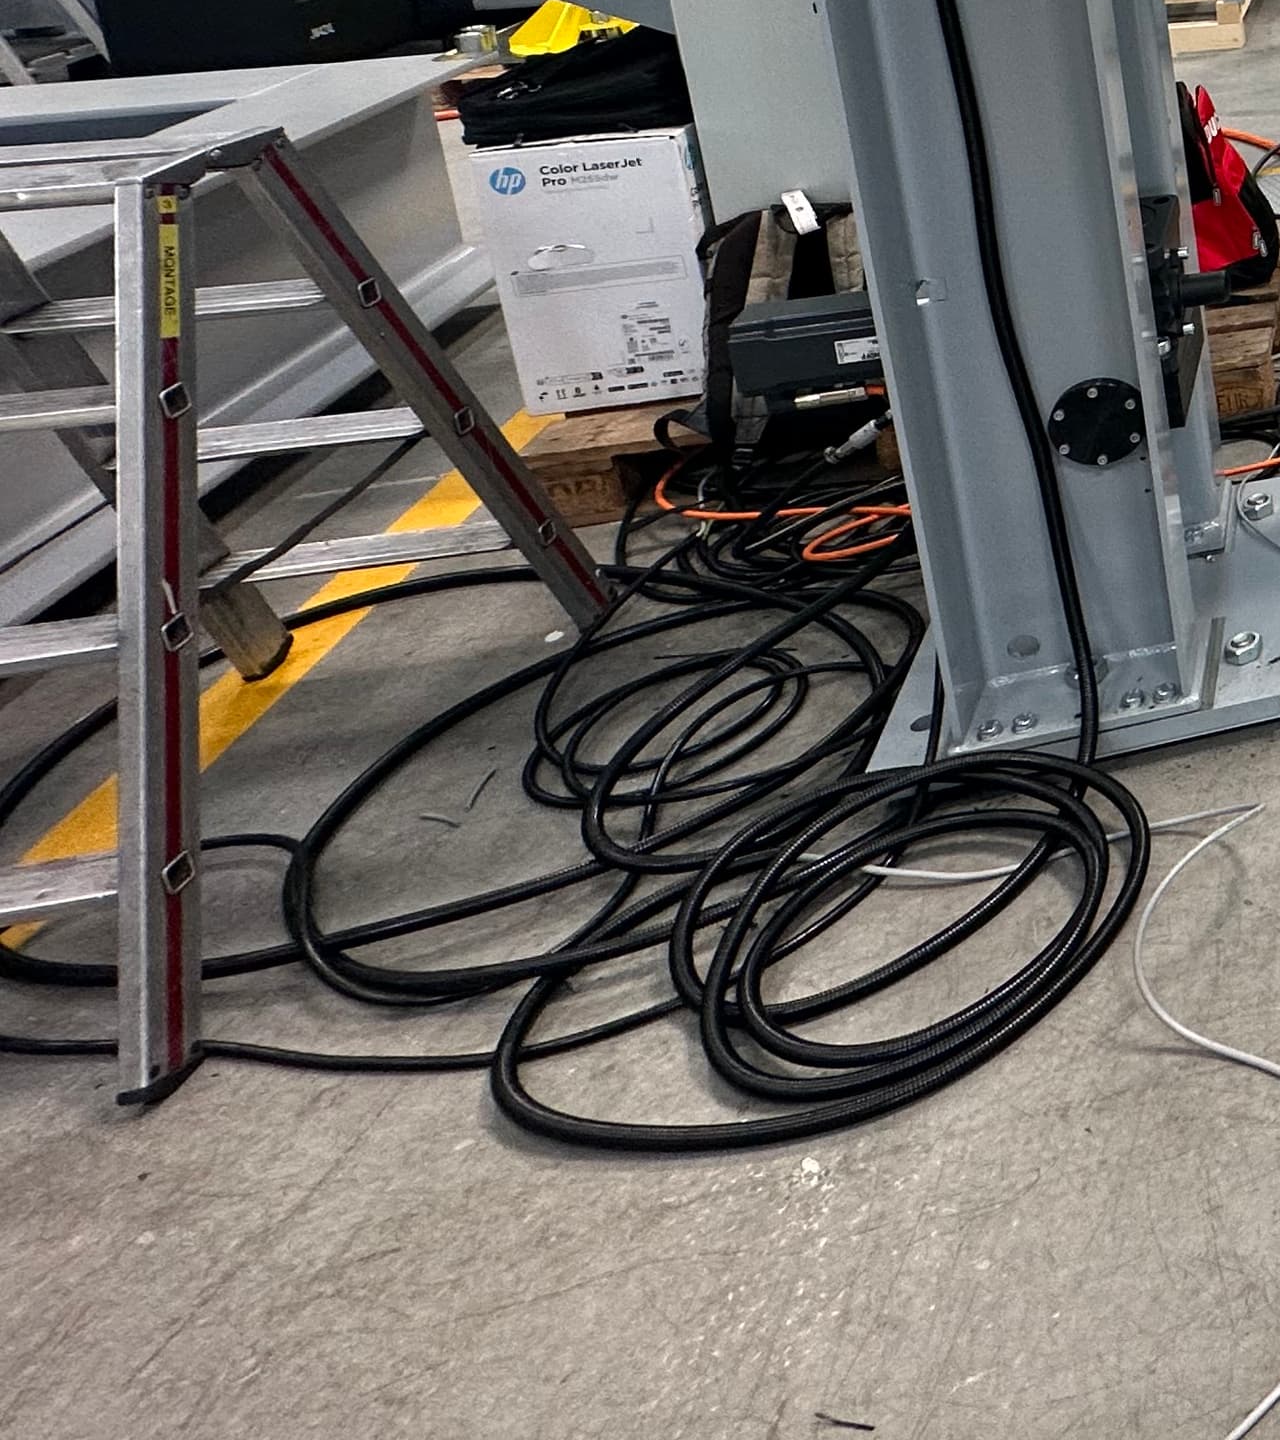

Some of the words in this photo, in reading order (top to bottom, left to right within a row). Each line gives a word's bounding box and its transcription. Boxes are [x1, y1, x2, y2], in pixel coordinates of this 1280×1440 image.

[539, 164, 579, 176] Color
[582, 158, 643, 172] LaserJet
[494, 167, 523, 195] hp
[542, 177, 567, 188] Pro
